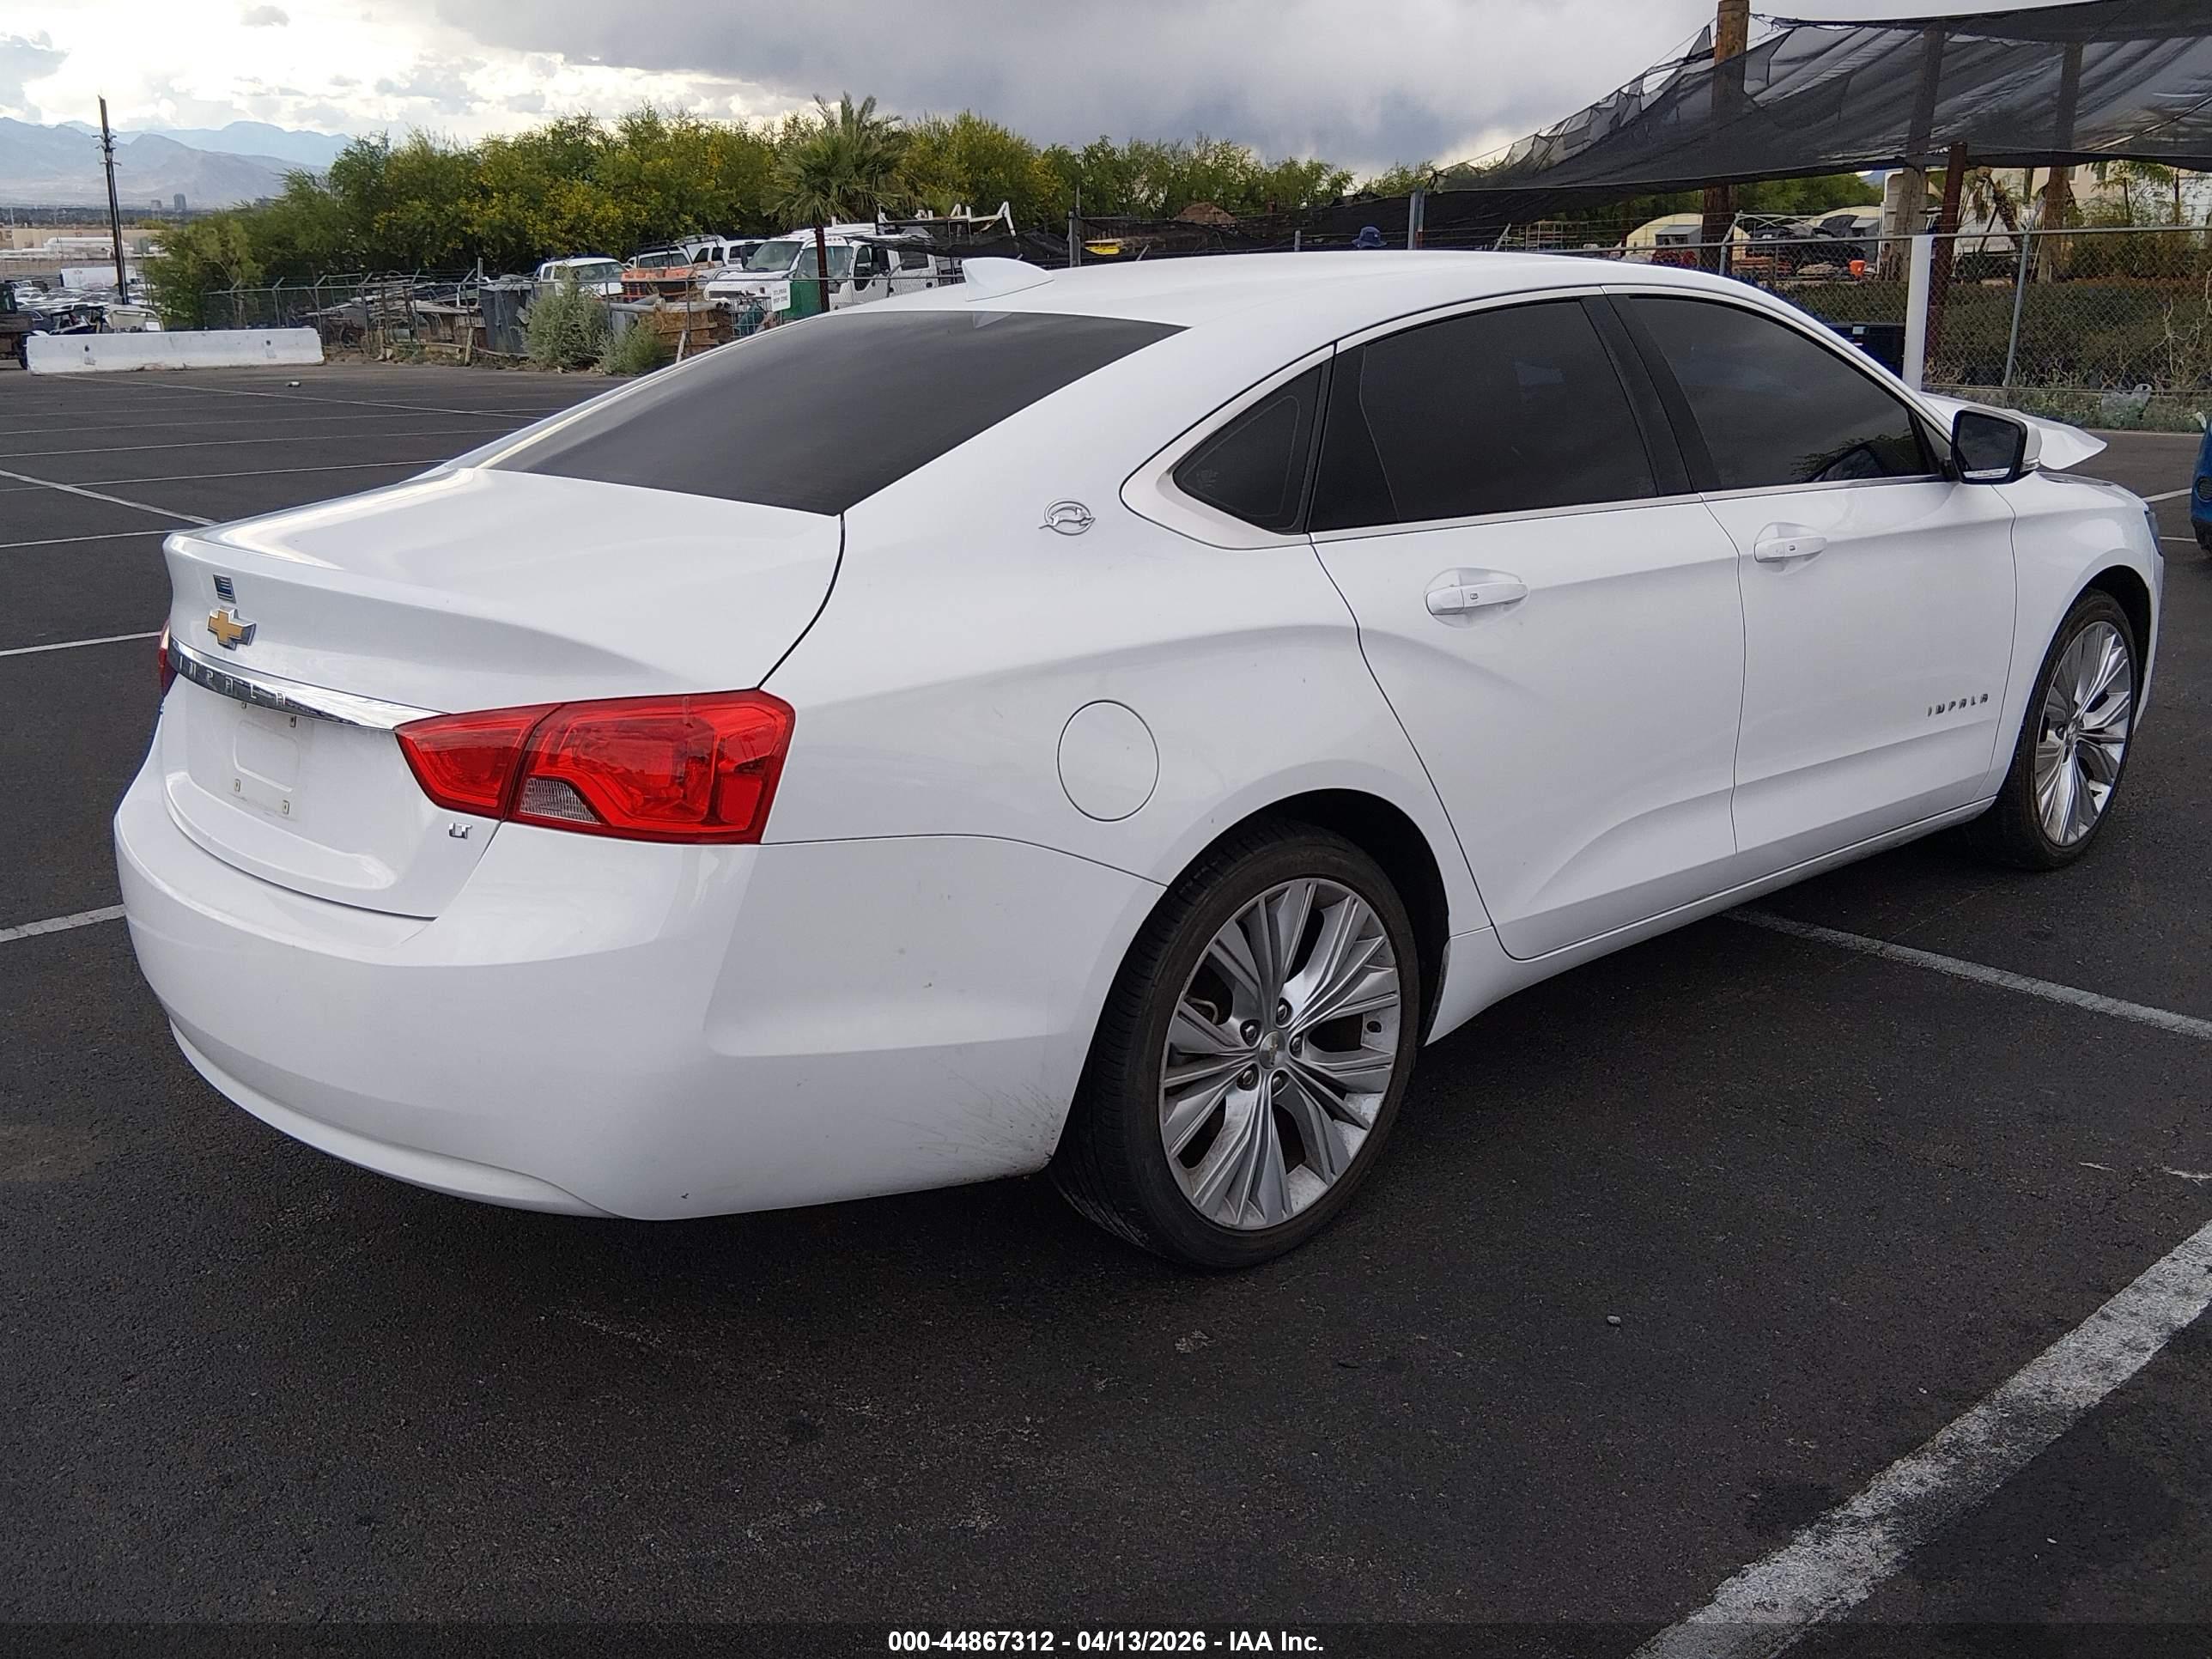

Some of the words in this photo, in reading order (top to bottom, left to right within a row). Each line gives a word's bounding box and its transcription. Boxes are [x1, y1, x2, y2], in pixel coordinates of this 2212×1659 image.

[179, 654, 287, 707] IMPALA
[1928, 693, 1989, 717] IMPALA
[448, 822, 473, 840] LT
